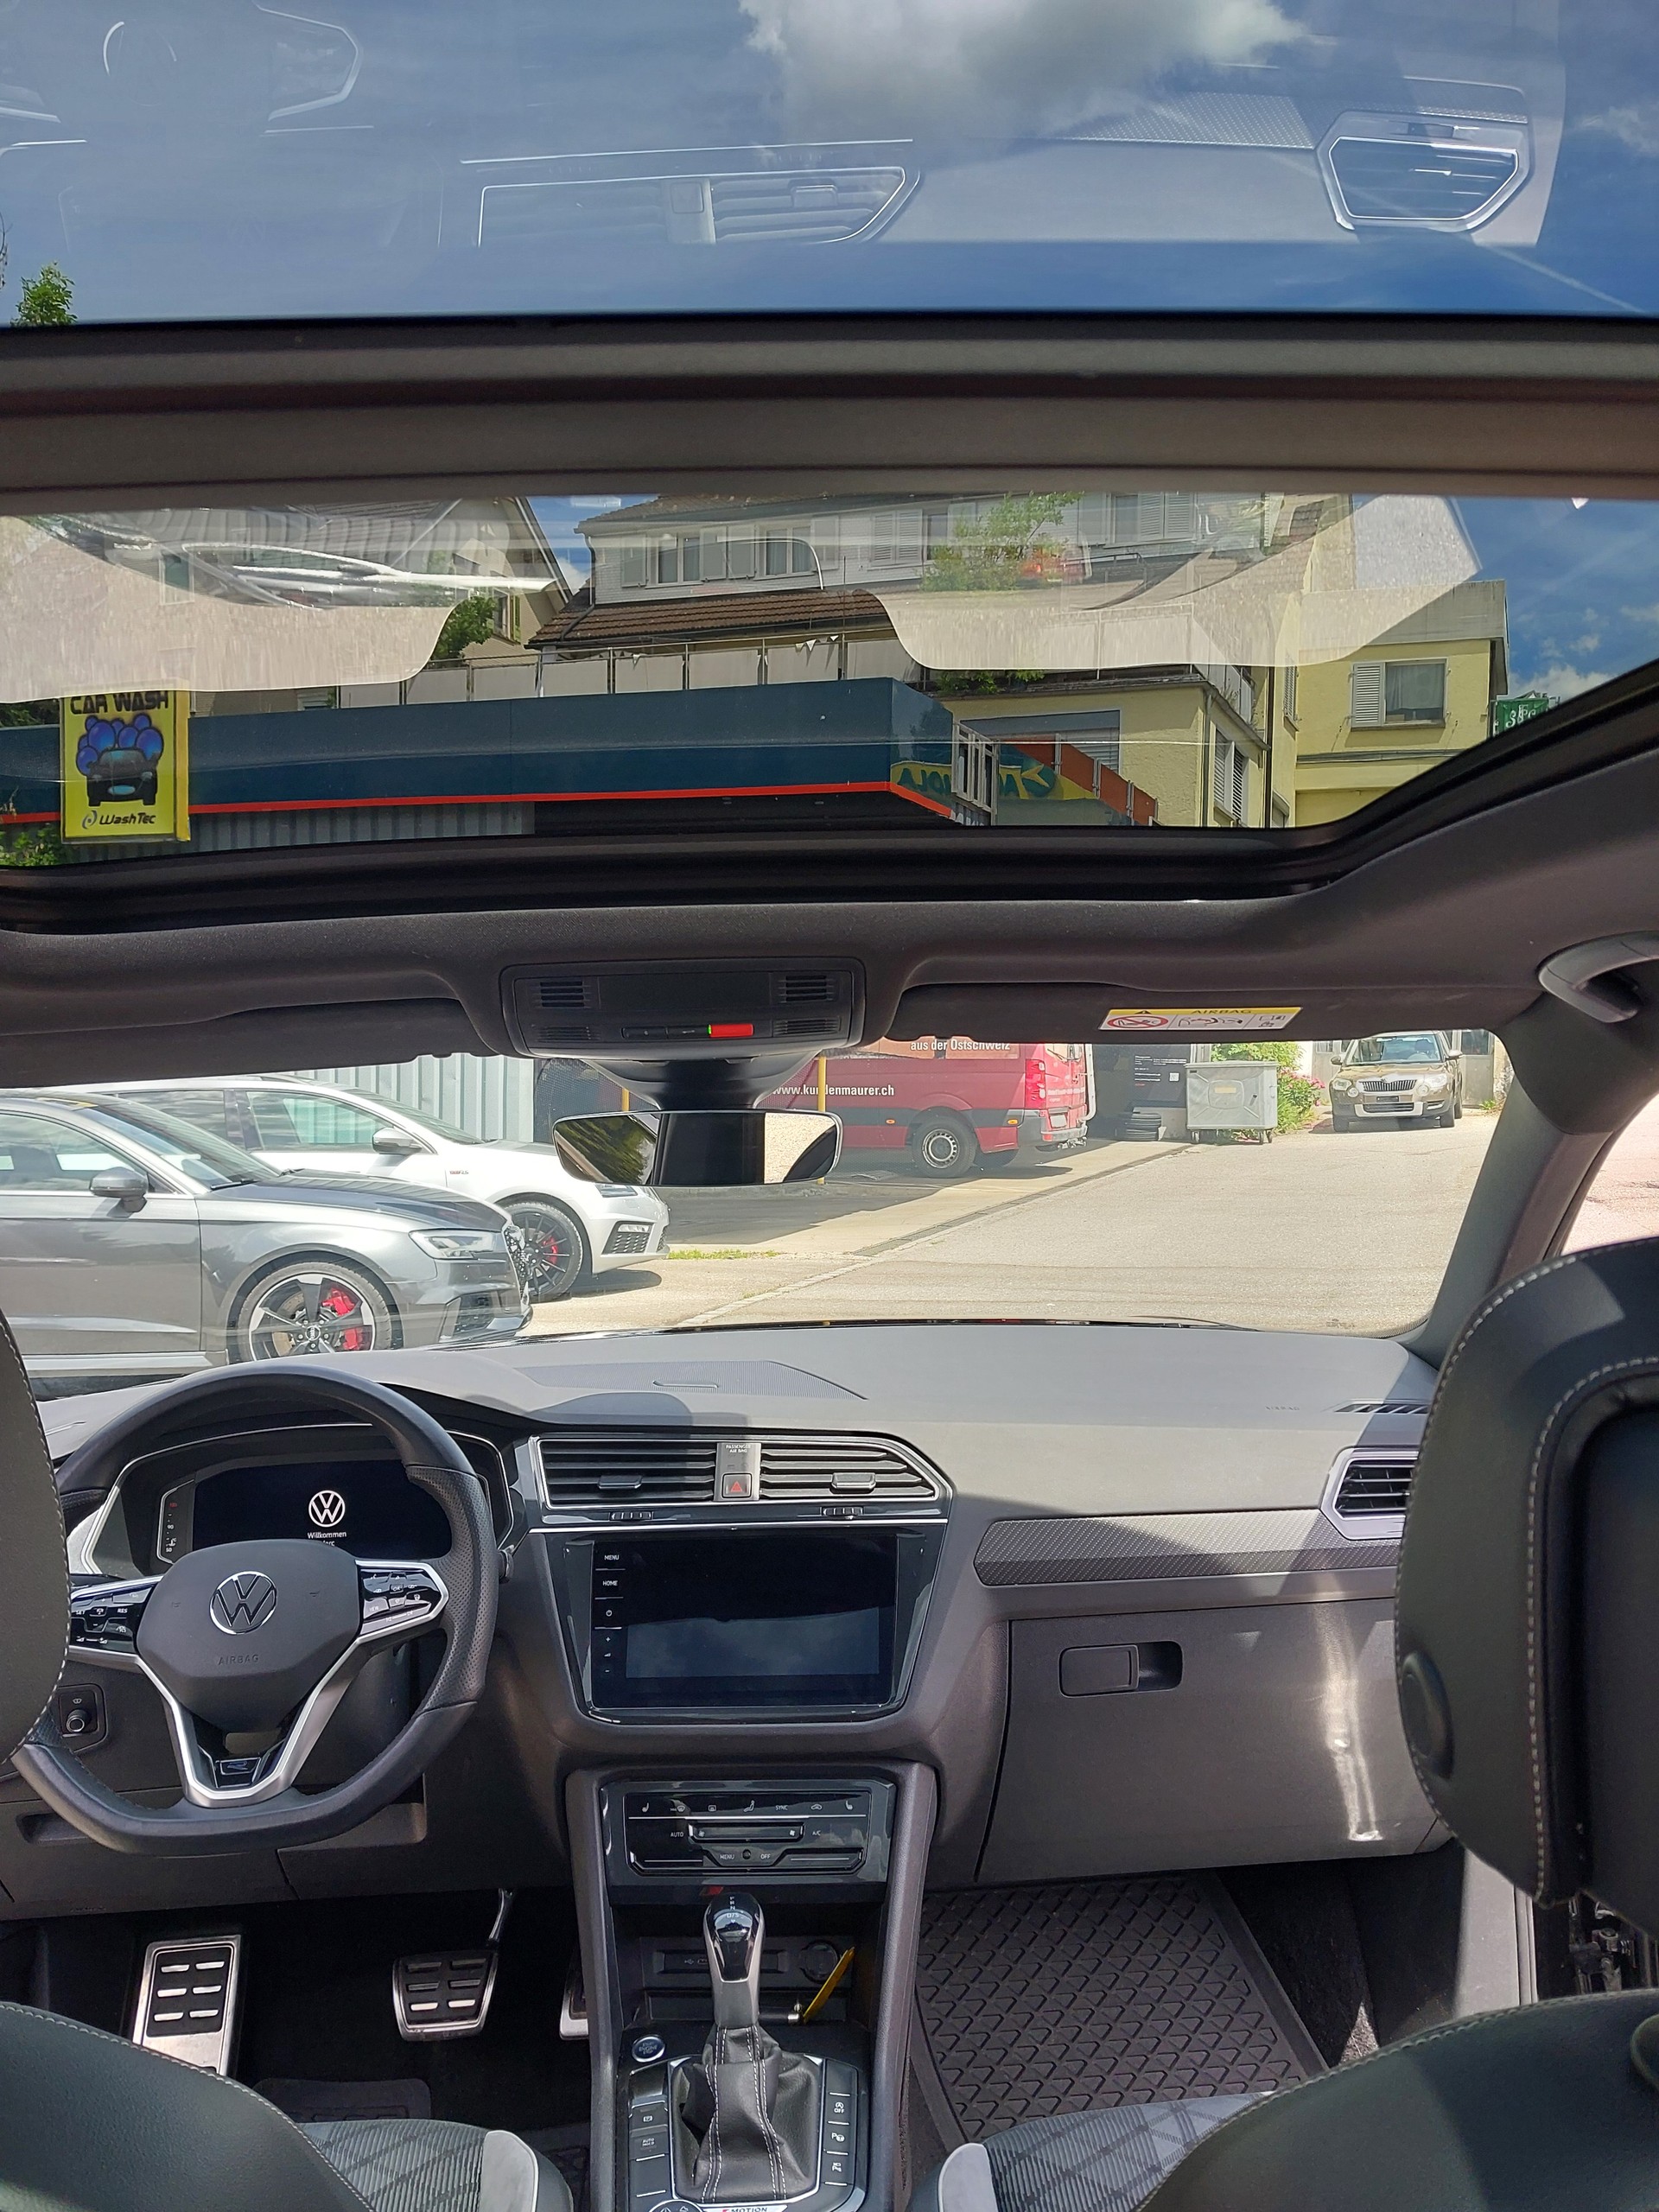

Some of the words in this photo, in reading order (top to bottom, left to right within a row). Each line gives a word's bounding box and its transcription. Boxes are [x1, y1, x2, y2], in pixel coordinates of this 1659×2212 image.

[71, 694, 108, 715] CAR
[113, 691, 168, 712] WASH
[99, 812, 156, 825] WashTec
[910, 1041, 929, 1051] aus
[931, 1039, 948, 1051] der
[218, 1654, 259, 1666] AIRBAG
